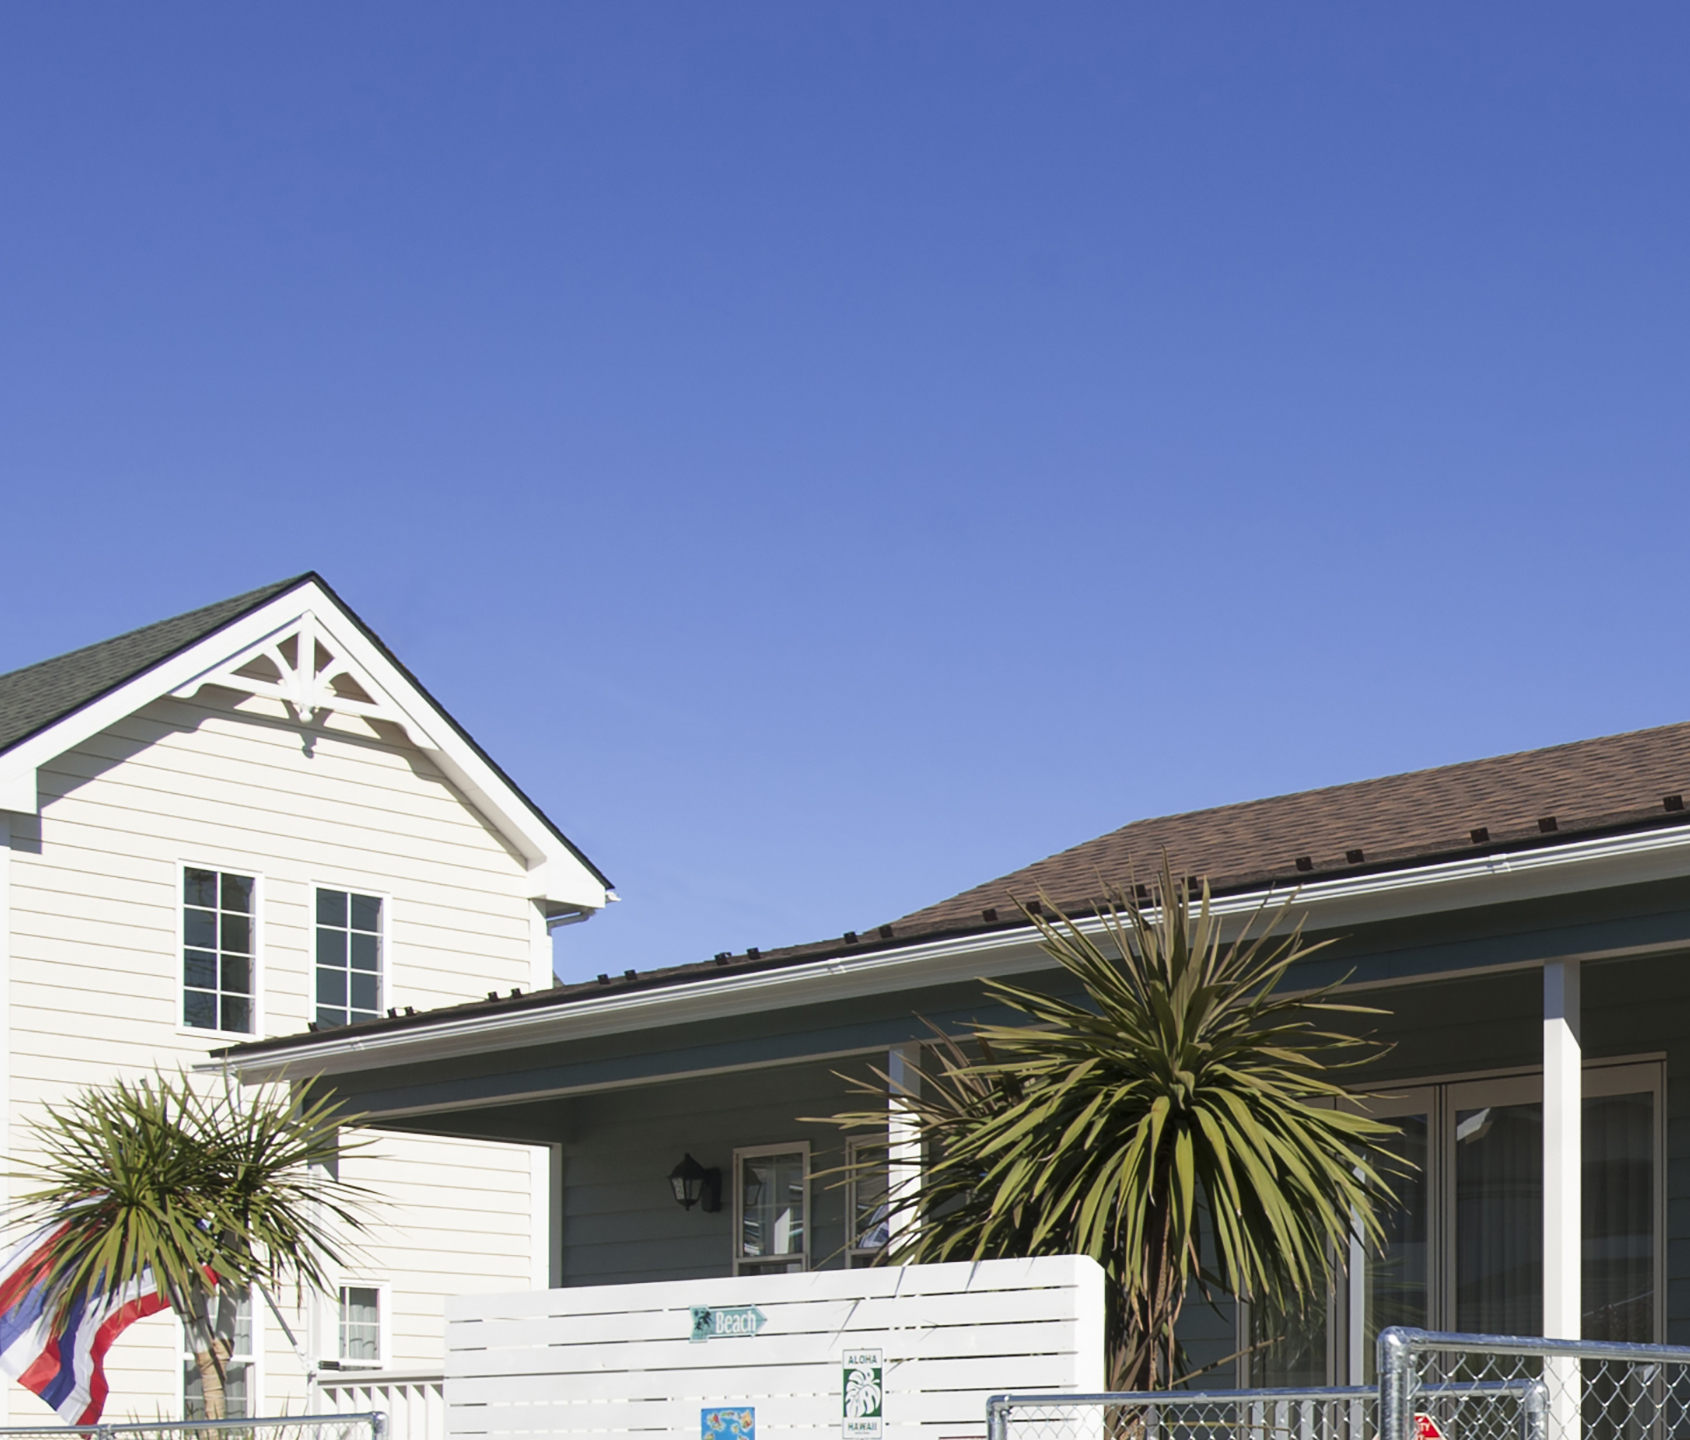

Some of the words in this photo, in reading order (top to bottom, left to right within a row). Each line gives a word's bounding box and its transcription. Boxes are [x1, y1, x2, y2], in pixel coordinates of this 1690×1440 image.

[715, 1310, 756, 1334] Beach
[848, 1355, 877, 1365] ALOHA
[848, 1422, 877, 1431] HAWAII
